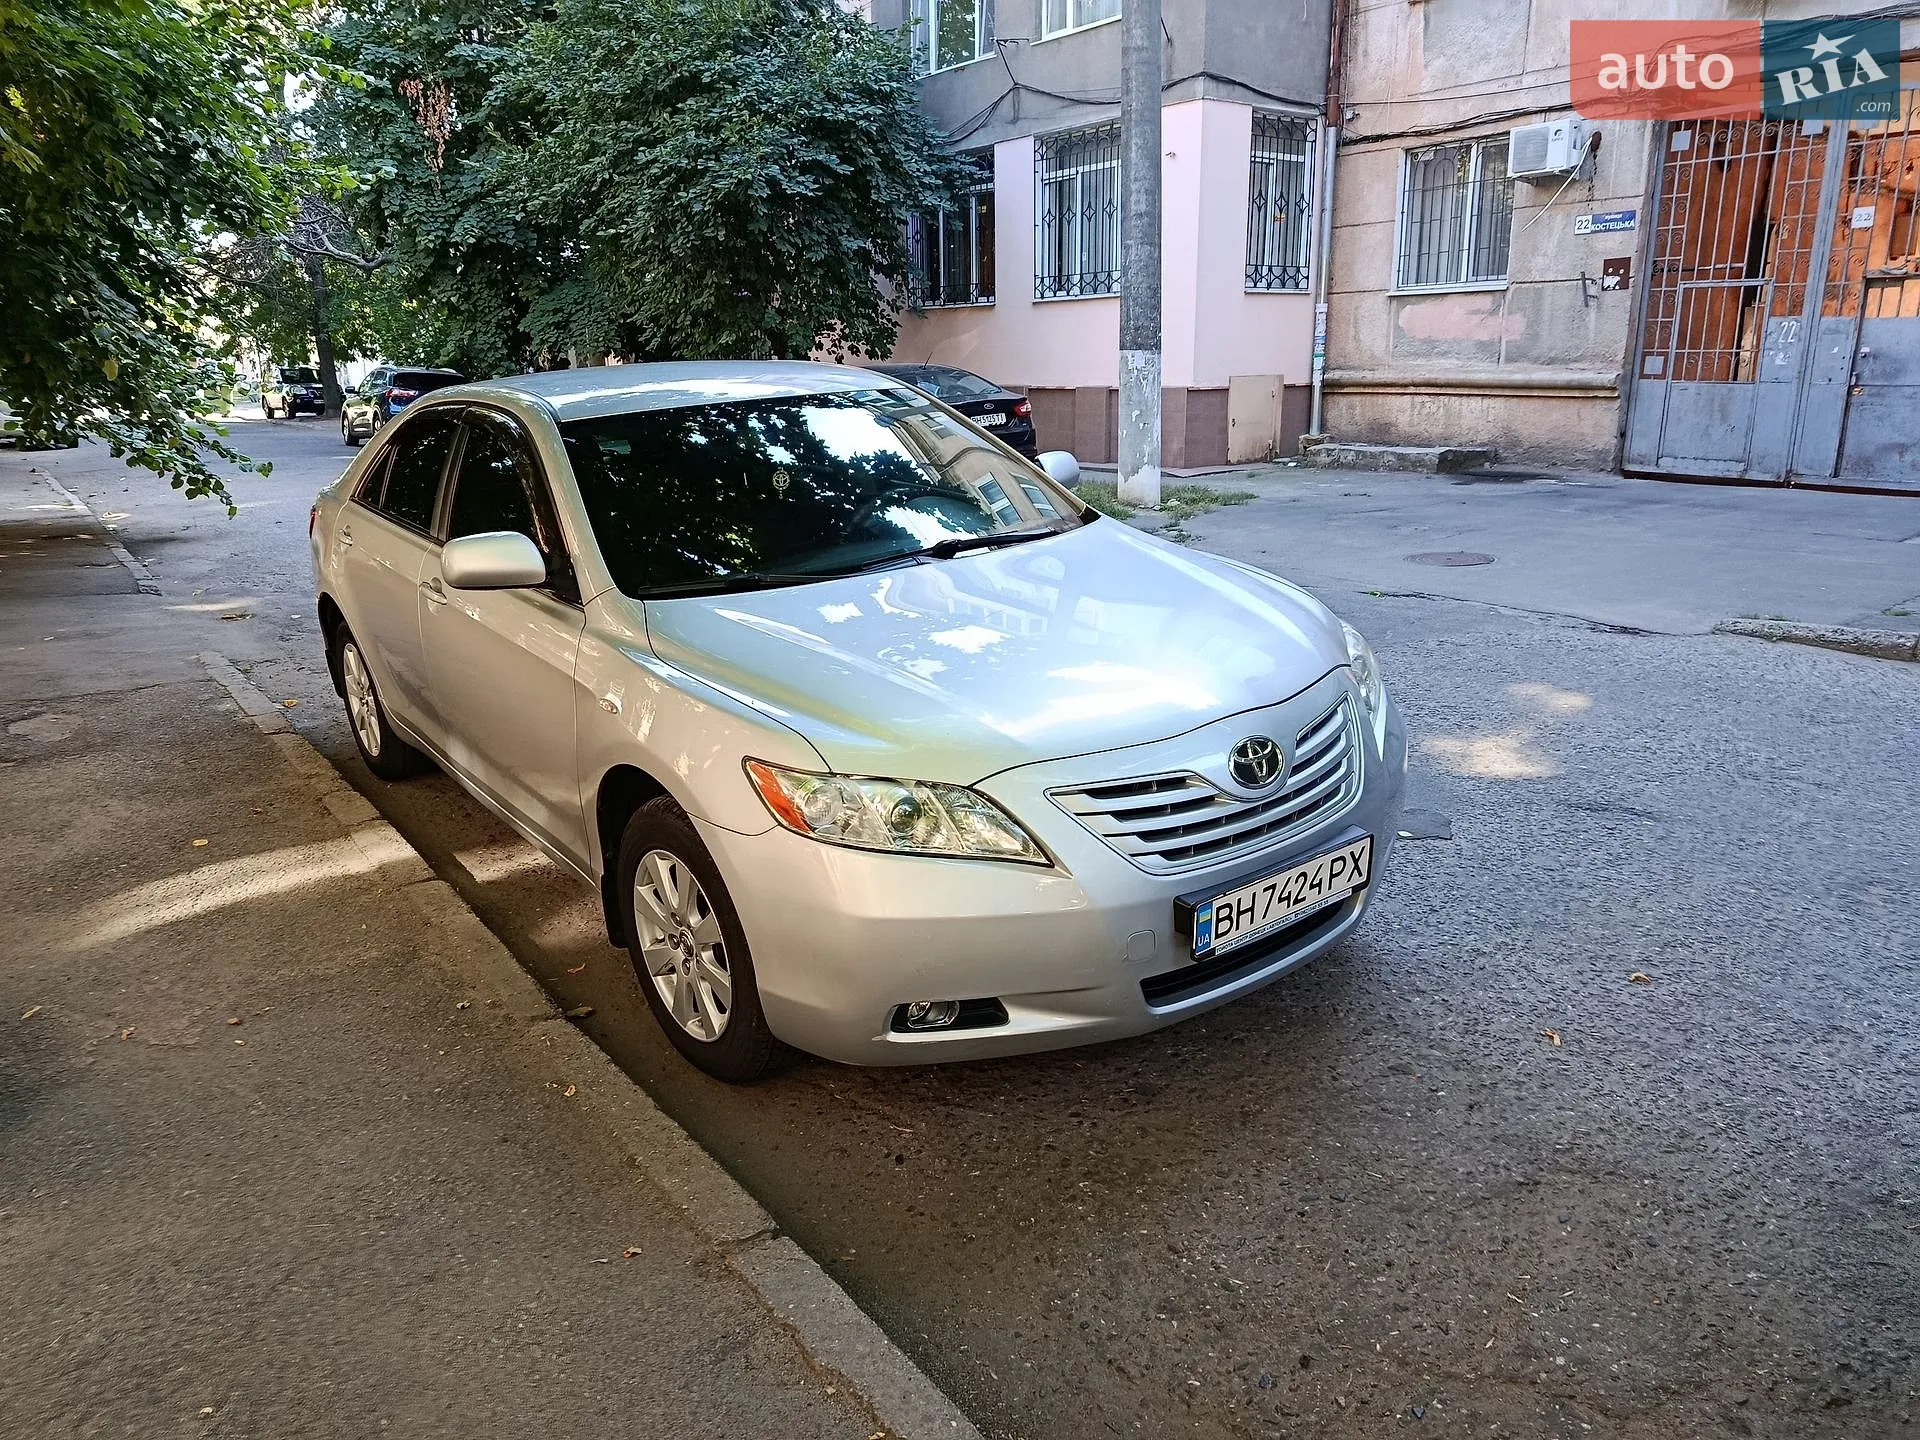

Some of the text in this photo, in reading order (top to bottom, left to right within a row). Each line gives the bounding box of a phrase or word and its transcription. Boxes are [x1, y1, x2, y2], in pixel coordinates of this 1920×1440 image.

[1577, 219, 1634, 231] 22 КОСТЕЦЬКА
[1778, 320, 1798, 343] 22
[1197, 933, 1210, 947] UA
